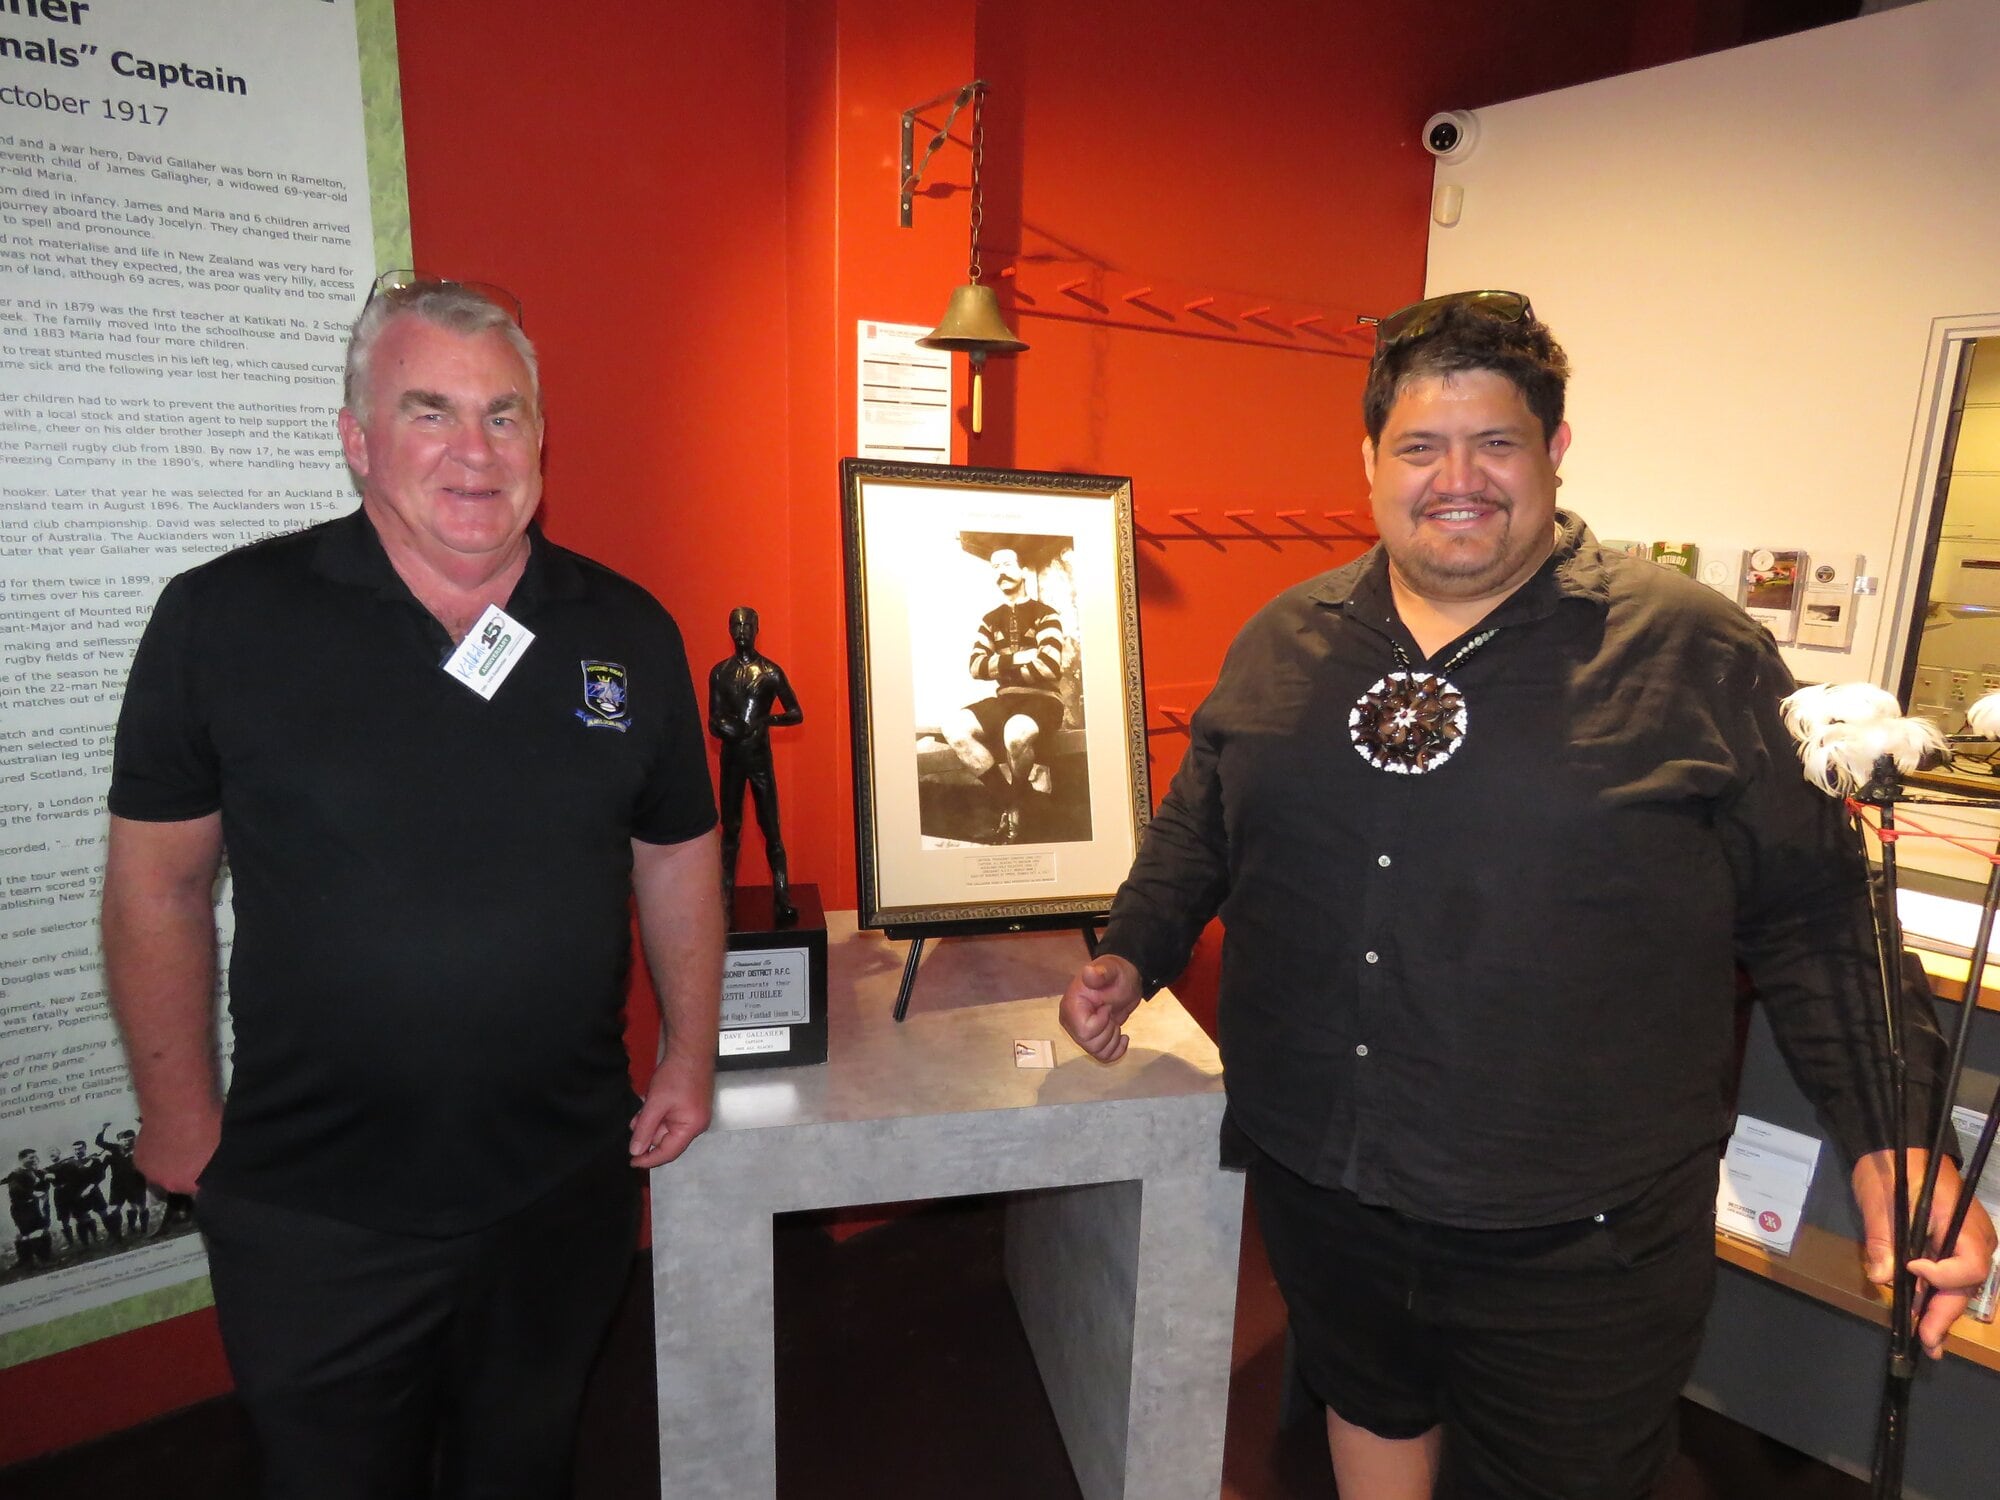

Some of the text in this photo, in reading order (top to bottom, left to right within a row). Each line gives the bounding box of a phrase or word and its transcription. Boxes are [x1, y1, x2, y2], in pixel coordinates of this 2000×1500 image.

[111, 51, 248, 96] Captain
[103, 99, 169, 127] 1917
[20, 139, 43, 149] and
[49, 143, 56, 151] a
[62, 144, 84, 154] war
[128, 152, 162, 164] David
[166, 157, 216, 171] Gallaher
[221, 166, 243, 175] was
[248, 168, 273, 179] born
[277, 173, 287, 181] in
[52, 156, 81, 168] child
[88, 161, 100, 170] of
[107, 163, 145, 176] James
[230, 181, 278, 193] widowed
[284, 186, 347, 202] 69-year-old
[4, 215, 16, 224] to
[22, 218, 51, 228] spell
[57, 222, 80, 231] and
[22, 187, 49, 199] died
[55, 192, 66, 200] in
[124, 199, 162, 211] James
[167, 205, 189, 215] and
[193, 207, 225, 218] Maria
[230, 213, 250, 222] and
[254, 214, 262, 223] 6
[265, 216, 308, 228] children
[313, 222, 350, 232] arrived
[53, 206, 97, 218] aboard
[101, 210, 122, 221] the
[126, 213, 154, 226] Lady
[210, 222, 238, 235] They
[242, 227, 289, 240] changed
[293, 232, 318, 242] their
[322, 236, 351, 246] name
[13, 237, 353, 276] not materialise and life in New Zealand was very hard for
[30, 253, 50, 262] not
[56, 254, 87, 265] what
[91, 257, 118, 269] they
[186, 266, 205, 276] the
[209, 269, 234, 278] area
[238, 272, 260, 280] was
[264, 275, 288, 284] very
[320, 280, 354, 289] access
[17, 264, 29, 274] of
[70, 270, 125, 283] although
[129, 274, 144, 284] 69
[188, 281, 211, 290] was
[214, 283, 240, 292] poor
[244, 285, 280, 296] quality
[284, 289, 304, 297] and
[308, 288, 325, 299] too
[328, 293, 355, 301] small
[17, 299, 40, 308] and
[64, 302, 94, 312] 1879
[100, 306, 124, 314] was
[129, 306, 148, 316] the
[152, 308, 176, 318] first
[180, 311, 224, 322] teacher
[229, 315, 240, 323] at
[244, 316, 286, 326] Katikati
[313, 320, 319, 329] 2
[29, 361, 53, 370] sick
[58, 364, 81, 372] and
[86, 364, 105, 373] the
[110, 365, 163, 378] following
[197, 369, 217, 378] lost
[222, 367, 240, 380] her
[244, 373, 290, 384] teaching
[24, 441, 67, 451] Parnell
[72, 443, 107, 454] rugby
[112, 444, 137, 452] club
[140, 444, 169, 453] from
[211, 446, 224, 456] By
[277, 447, 290, 456] he
[52, 502, 83, 510] team
[88, 502, 99, 510] in
[104, 502, 144, 512] August
[188, 501, 208, 510] The
[213, 502, 280, 510] Aucklanders
[0, 548, 32, 556] Later
[38, 547, 63, 555] that
[69, 548, 95, 556] year
[100, 546, 150, 554] Gallaher
[182, 544, 230, 553] selected
[2, 972, 50, 985] Douglas
[749, 990, 783, 1000] JUBILEE
[724, 1030, 784, 1040] DAVE GALLAHER
